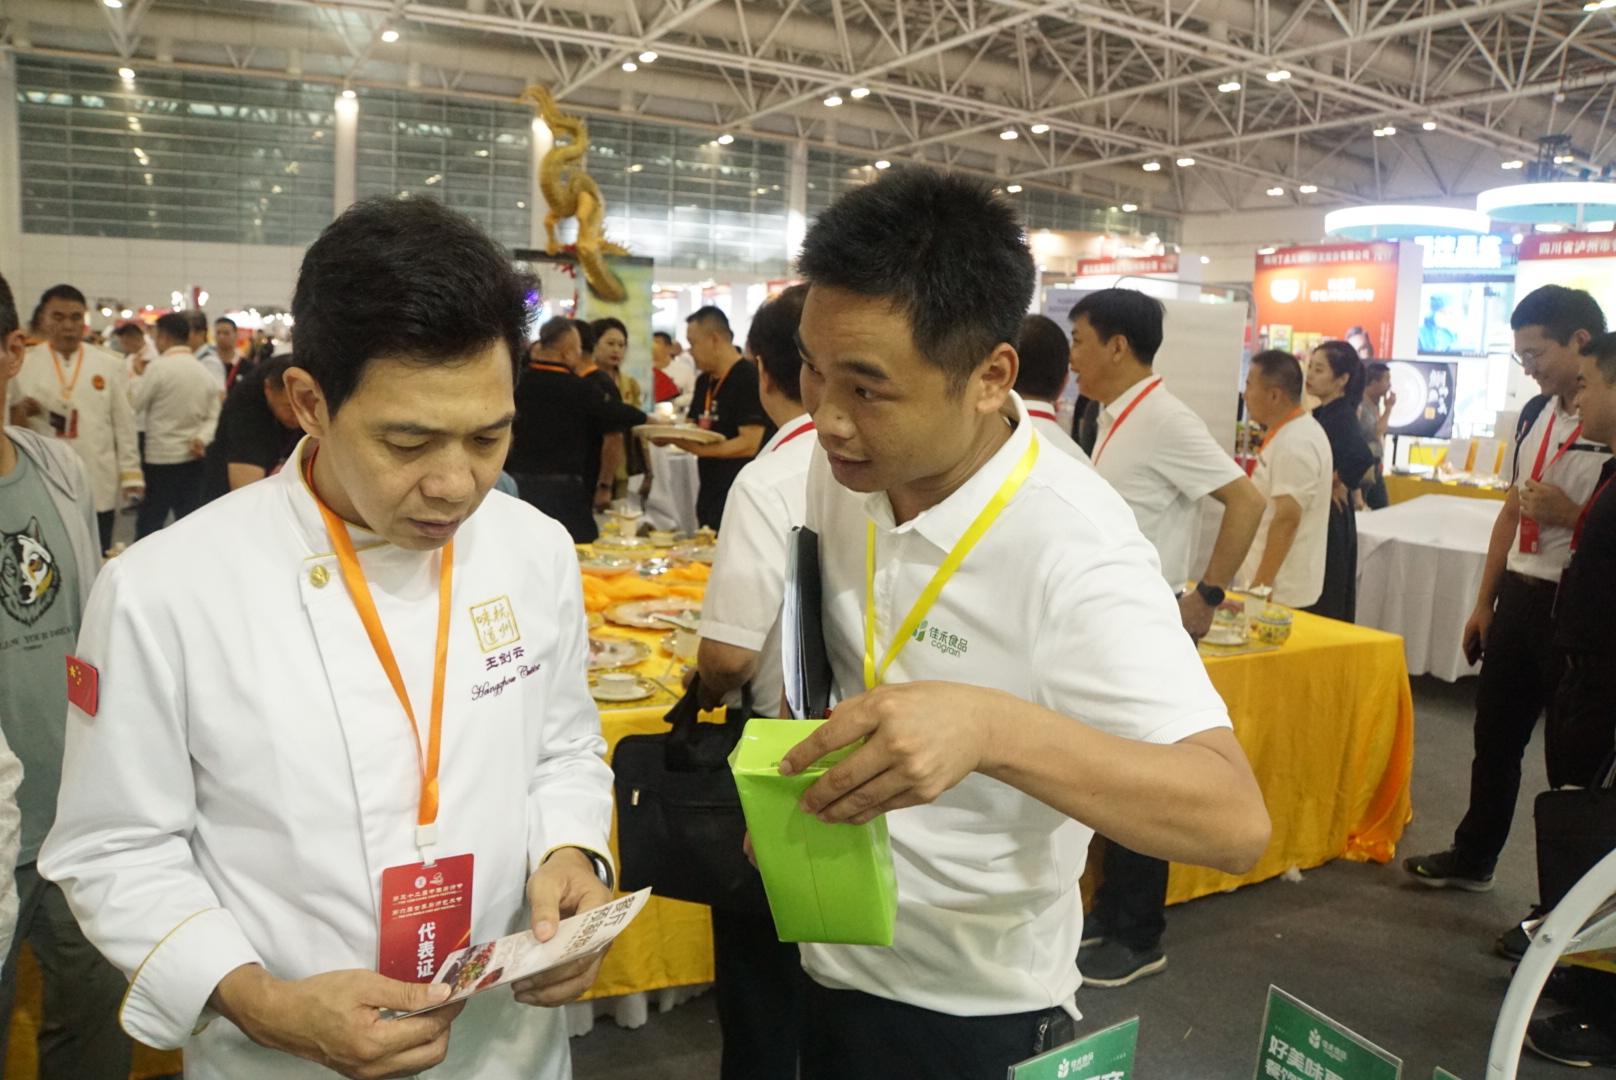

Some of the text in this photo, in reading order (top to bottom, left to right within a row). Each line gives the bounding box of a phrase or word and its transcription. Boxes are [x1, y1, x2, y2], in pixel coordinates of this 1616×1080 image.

[929, 626, 968, 653] 佳禾食品
[931, 640, 961, 658] cograin
[417, 921, 436, 978] 代表证
